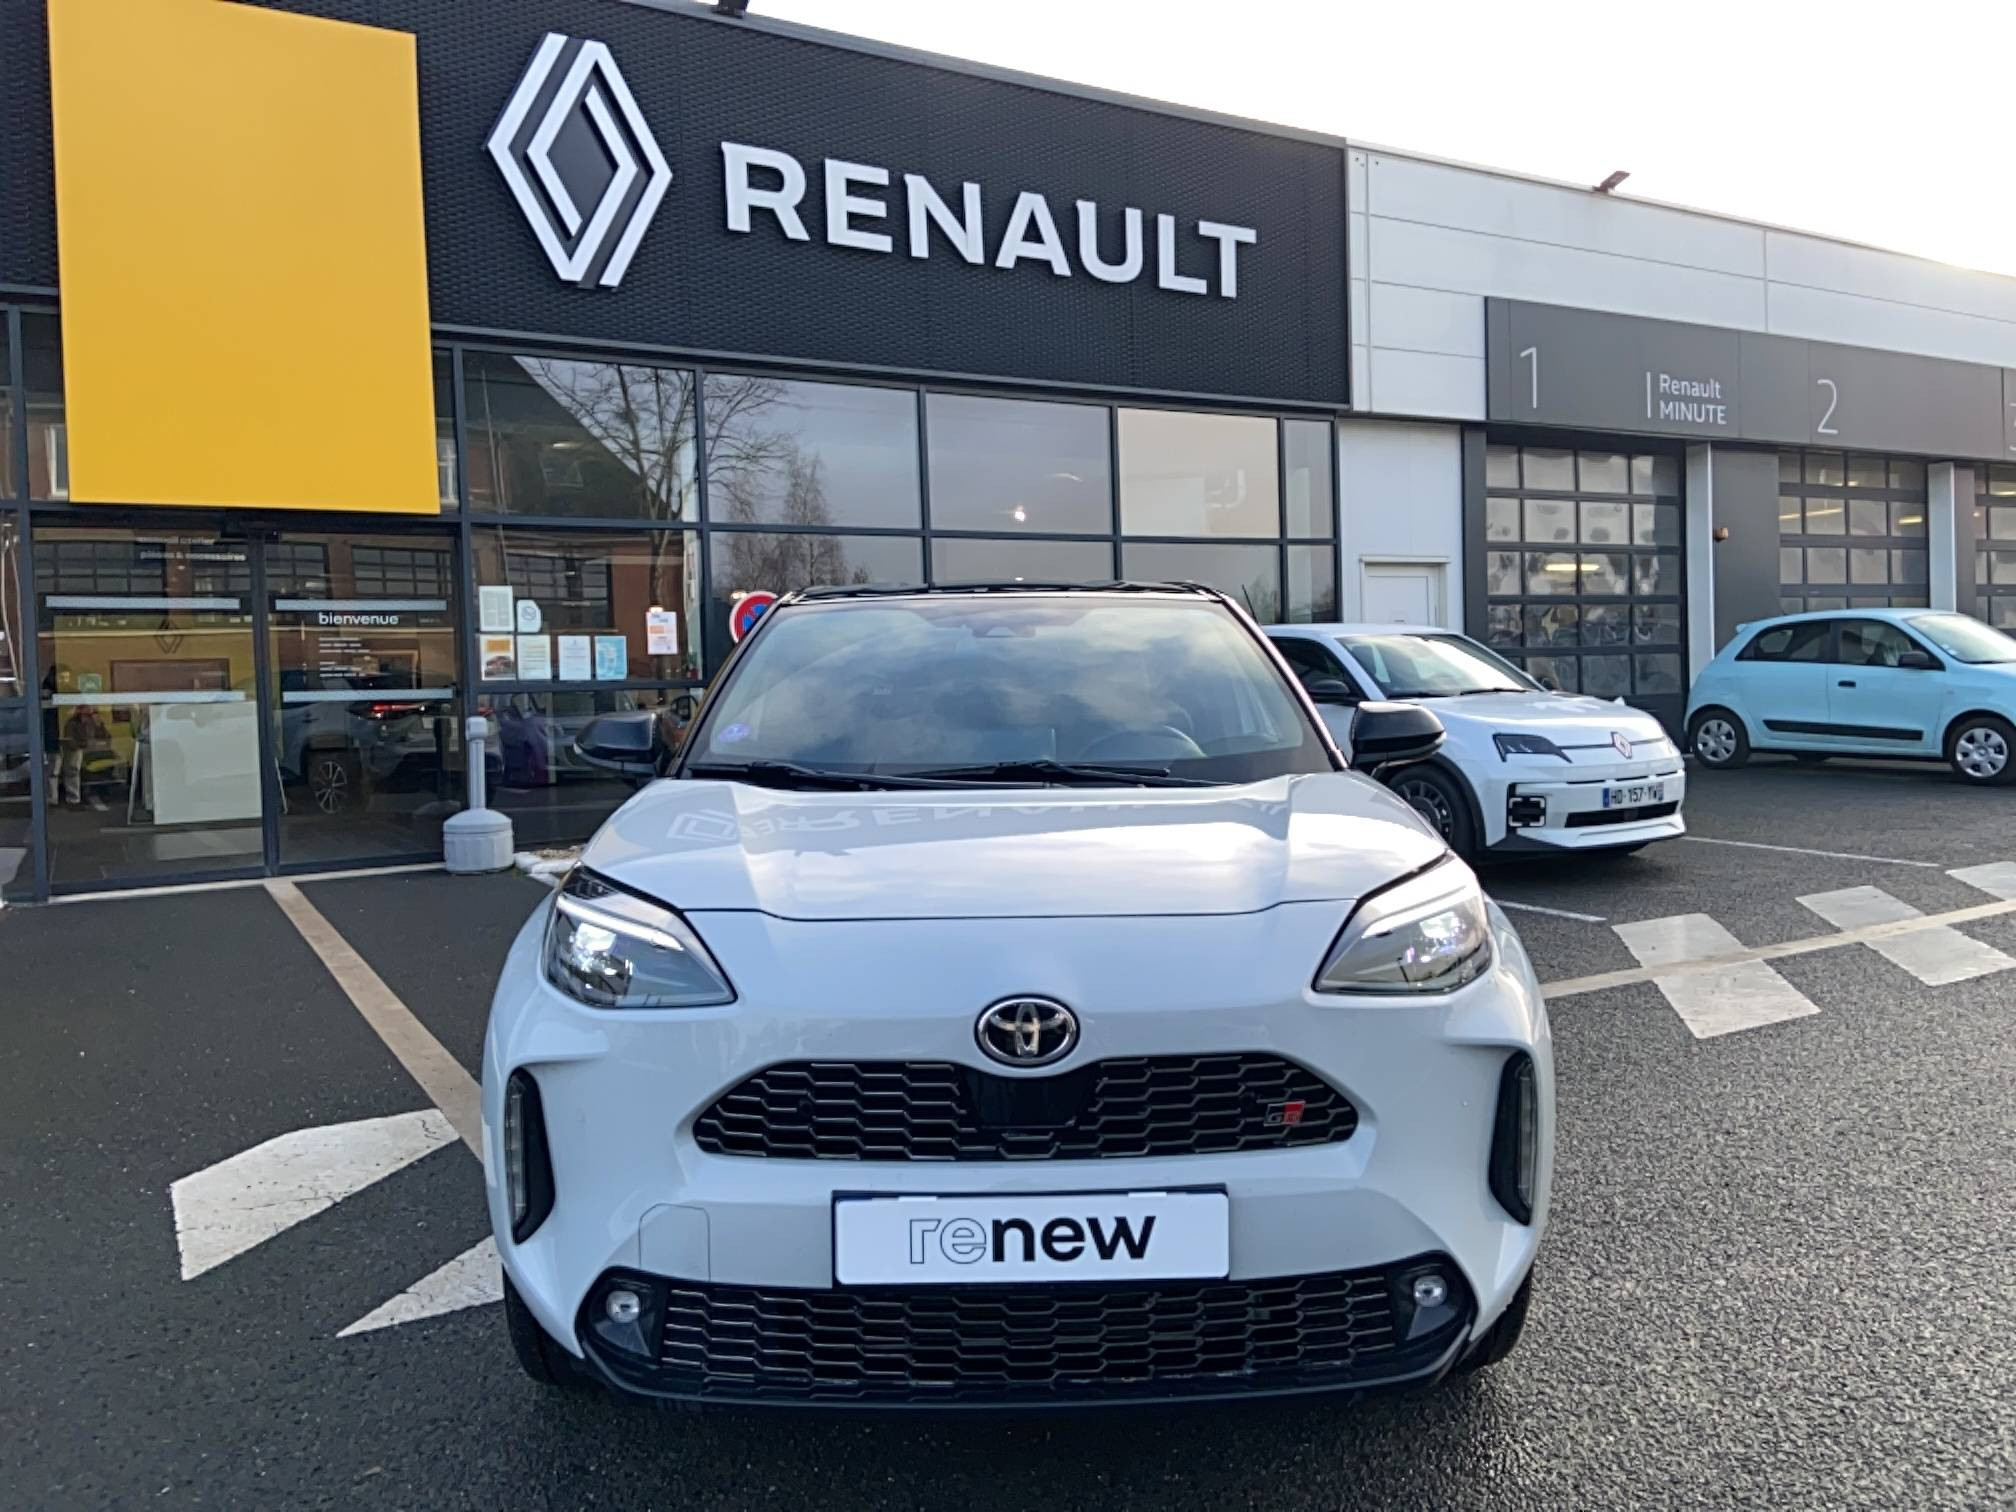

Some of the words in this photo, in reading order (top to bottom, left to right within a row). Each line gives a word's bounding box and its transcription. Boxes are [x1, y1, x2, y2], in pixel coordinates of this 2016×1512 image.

[721, 141, 1257, 298] RENAULT
[1519, 346, 1537, 409] 1
[1658, 373, 1722, 399] Renault
[1658, 400, 1728, 424] MINUTE
[1816, 378, 1839, 434] 2
[318, 611, 399, 625] bienvenue
[909, 1215, 1157, 1264] renew
